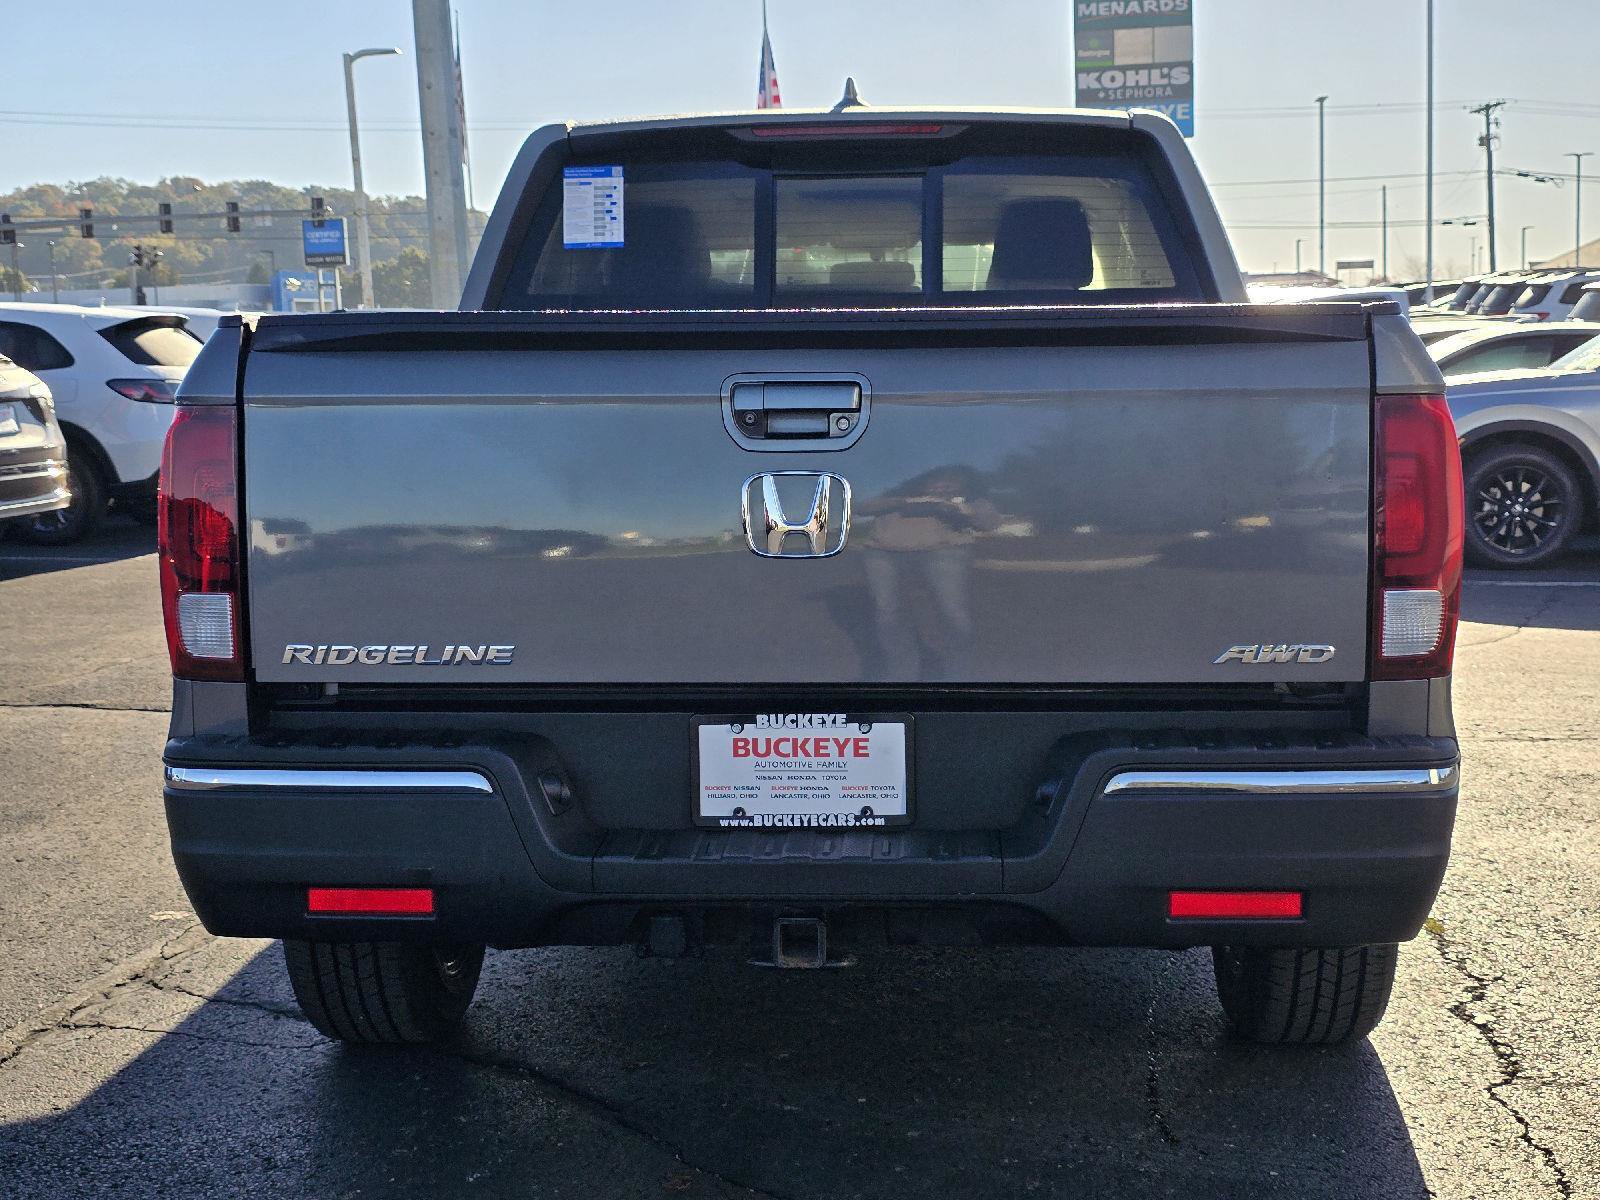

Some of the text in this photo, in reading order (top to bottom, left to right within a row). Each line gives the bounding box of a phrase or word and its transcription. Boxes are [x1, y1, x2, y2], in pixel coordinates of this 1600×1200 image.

[1077, 0, 1188, 17] MENARDS
[1078, 66, 1190, 89] KOHL'S
[1108, 87, 1173, 100] SEPHORA
[282, 644, 516, 665] RIDGELINE
[1212, 644, 1336, 664] AWD
[756, 714, 848, 729] BUCKEYE
[732, 737, 870, 758] BUCKEYE
[754, 761, 848, 769] AUTOMOTIVE FAMILY
[719, 813, 885, 827] www.BUCKEYECARS.com
